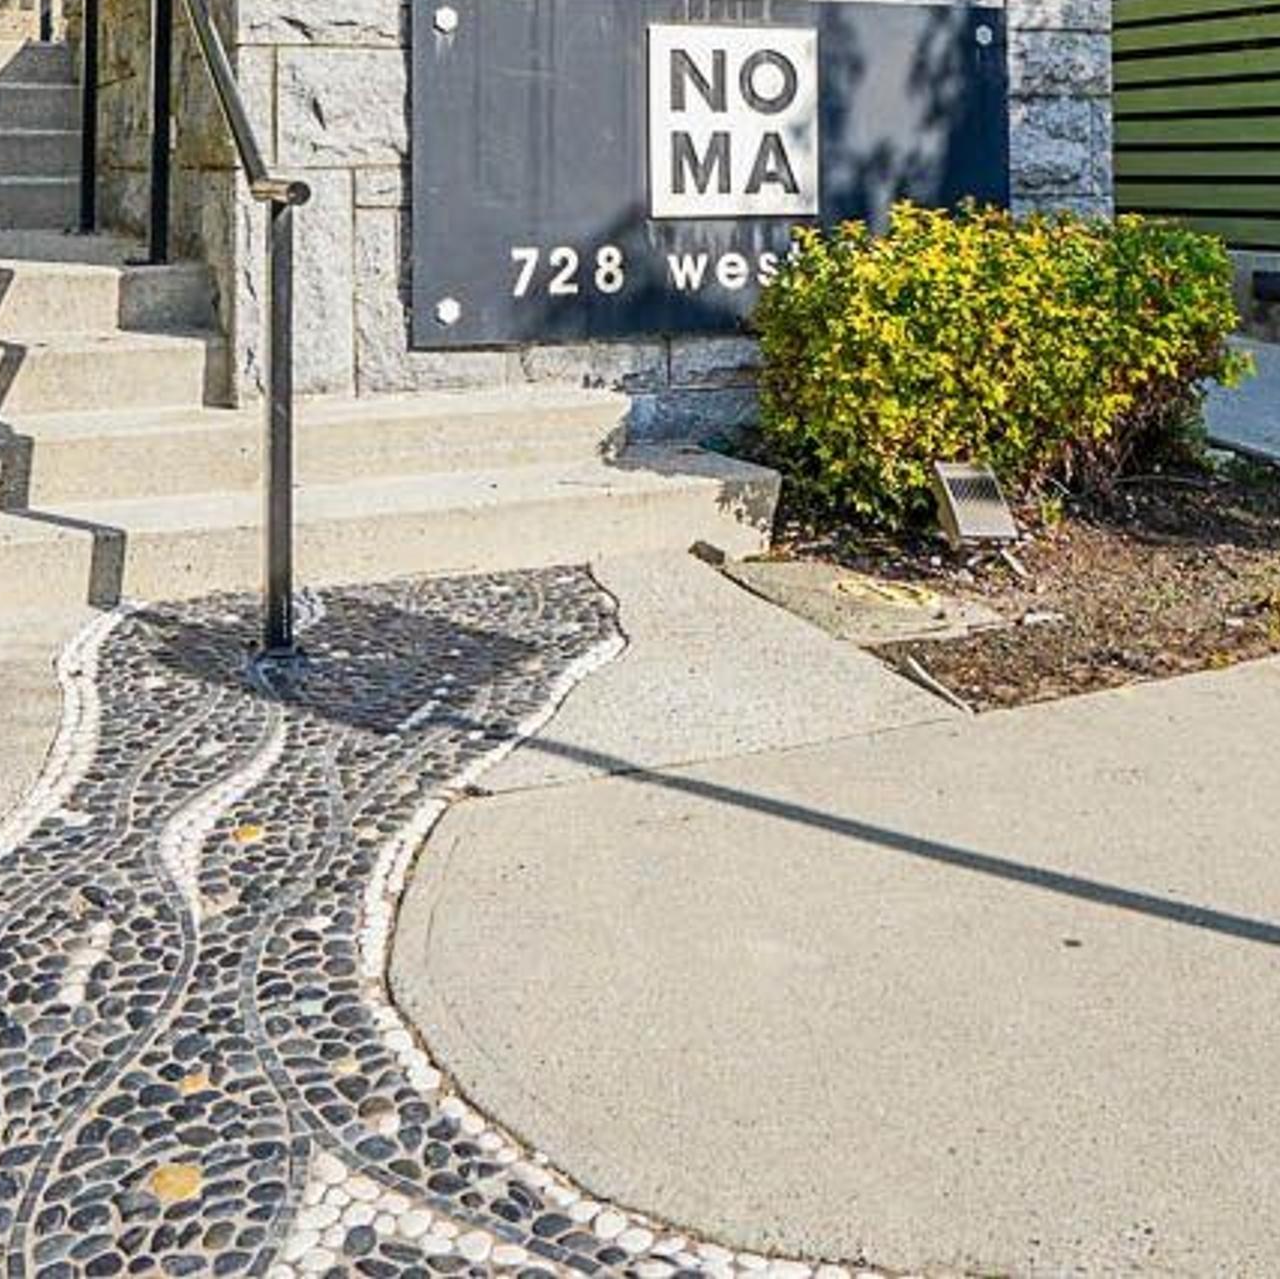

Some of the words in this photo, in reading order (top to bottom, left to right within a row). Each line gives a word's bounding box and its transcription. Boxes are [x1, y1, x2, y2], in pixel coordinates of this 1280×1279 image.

[670, 49, 797, 115] NO
[671, 131, 800, 194] MA
[511, 246, 624, 297] 728
